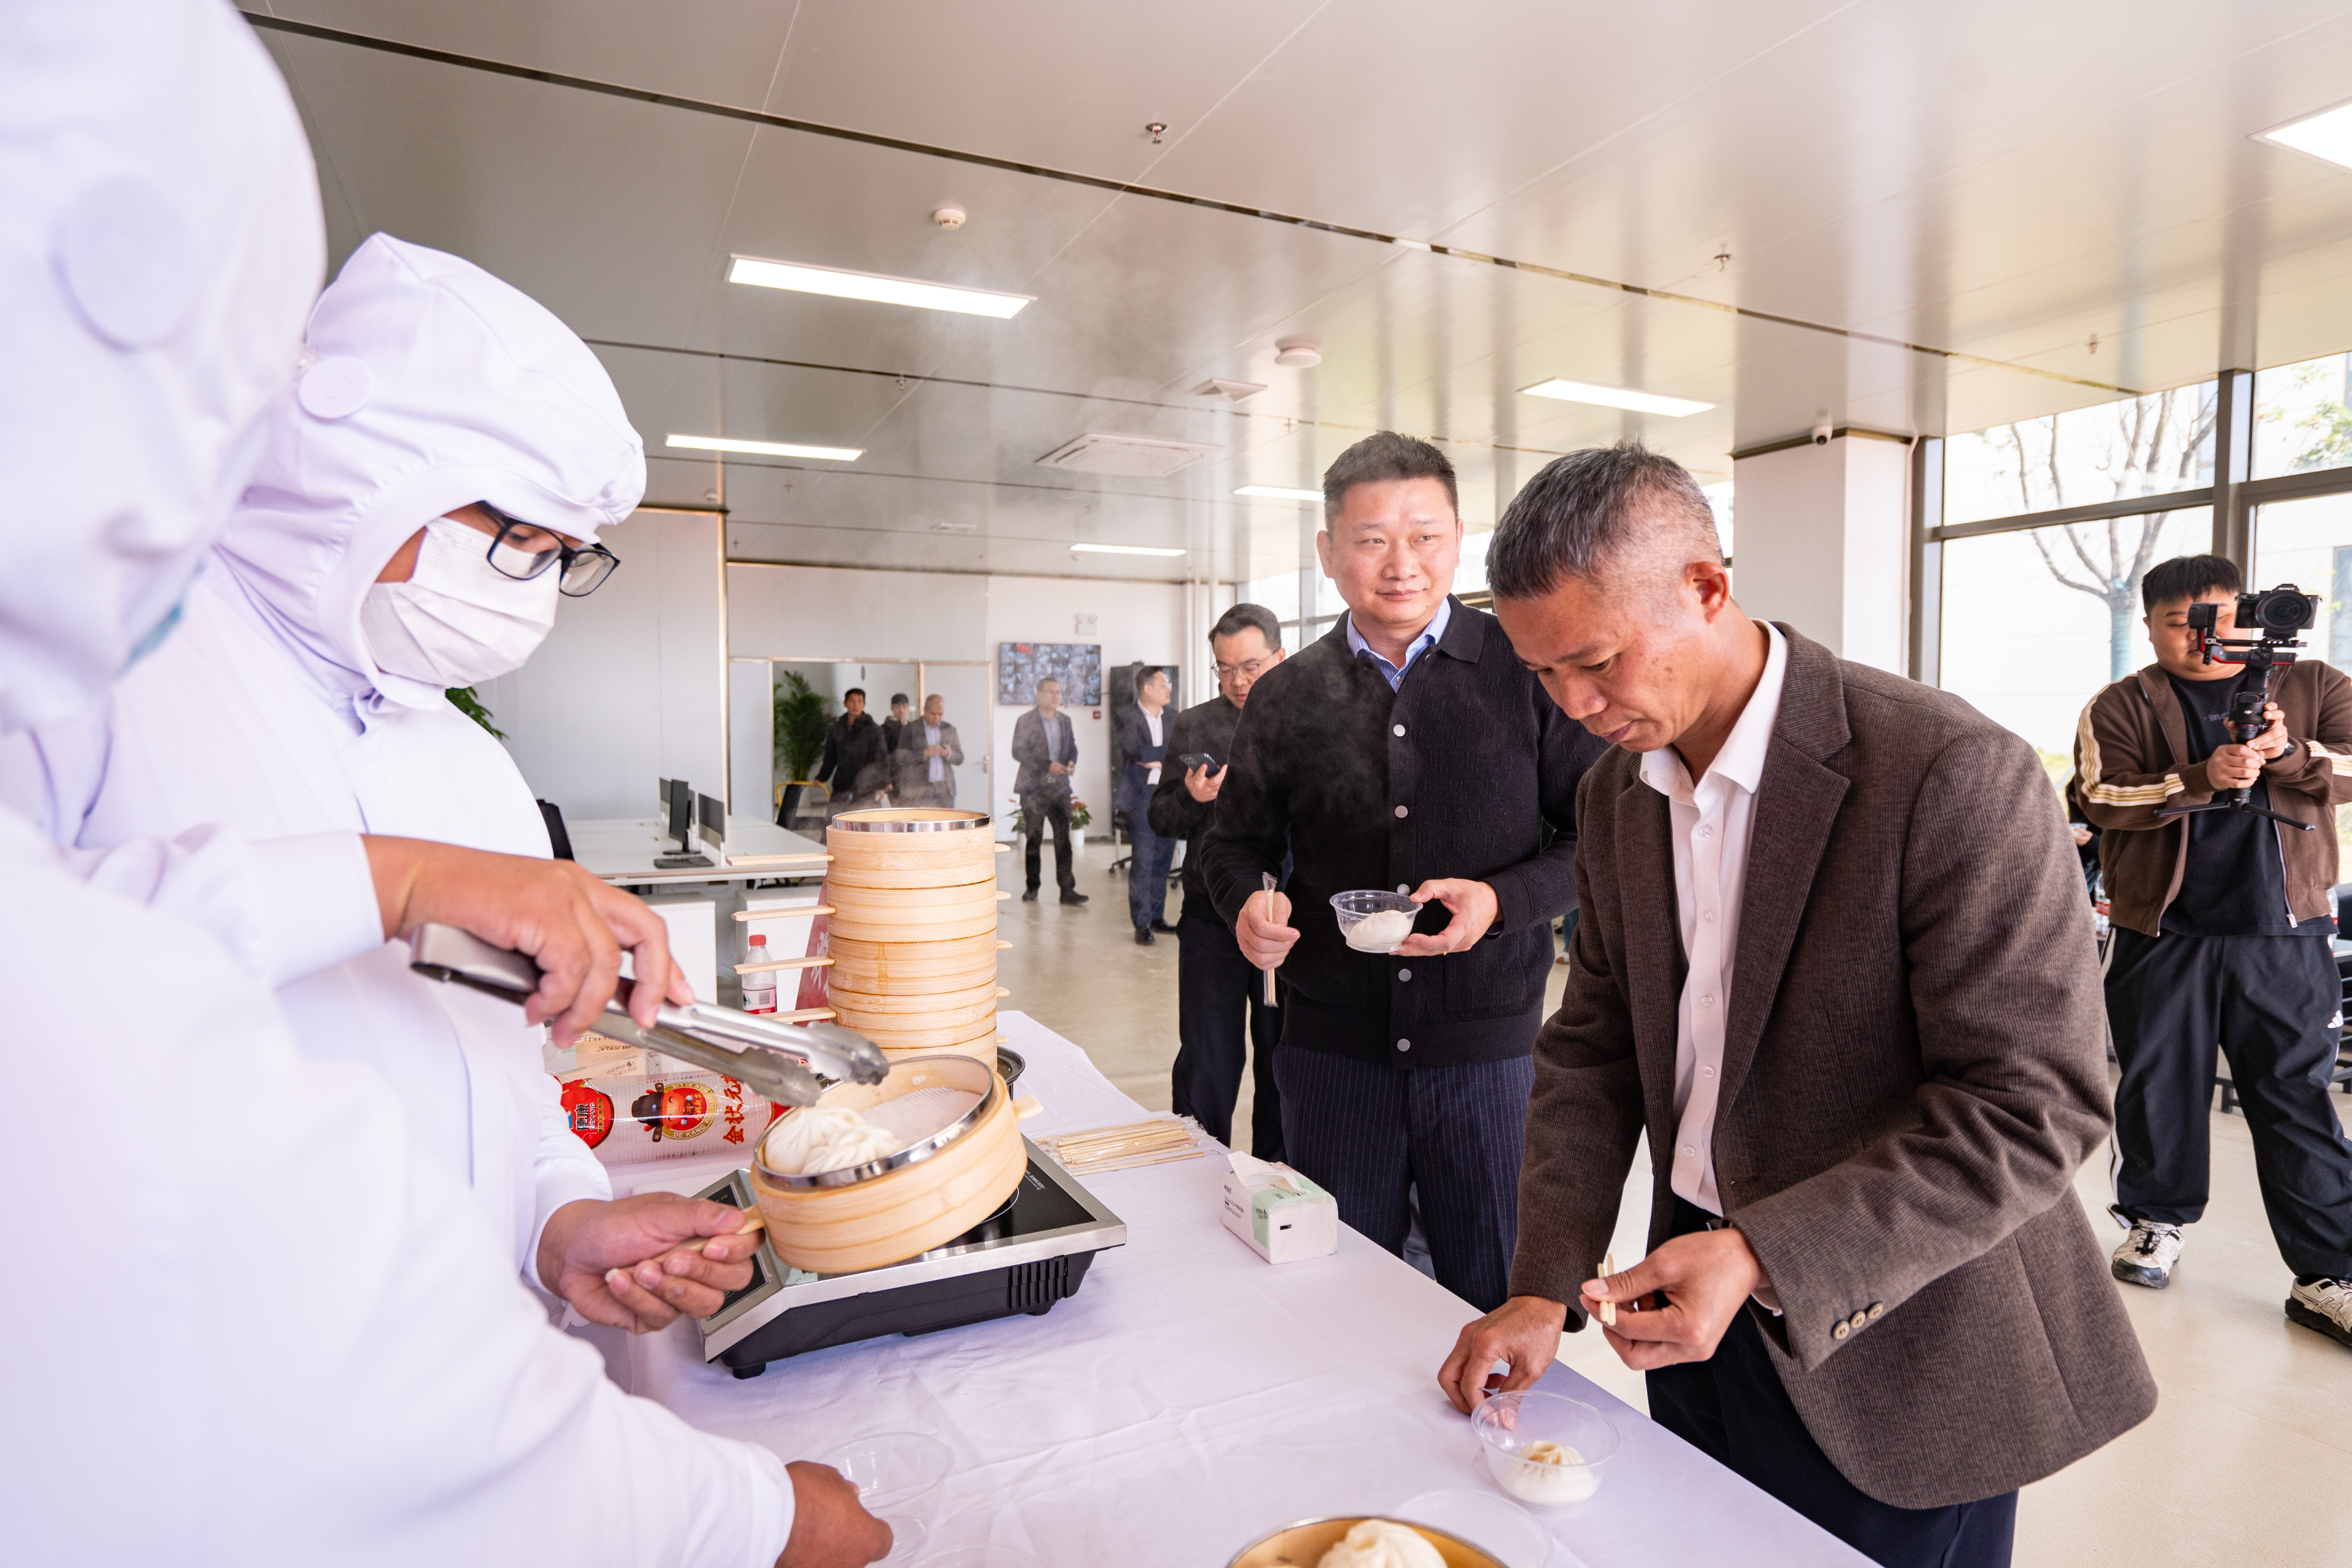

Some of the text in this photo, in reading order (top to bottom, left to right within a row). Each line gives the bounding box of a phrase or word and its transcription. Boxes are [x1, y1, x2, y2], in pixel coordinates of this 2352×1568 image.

[695, 1084, 709, 1093] WAN
[575, 1104, 589, 1131] 德康
[686, 1125, 706, 1137] KANG
